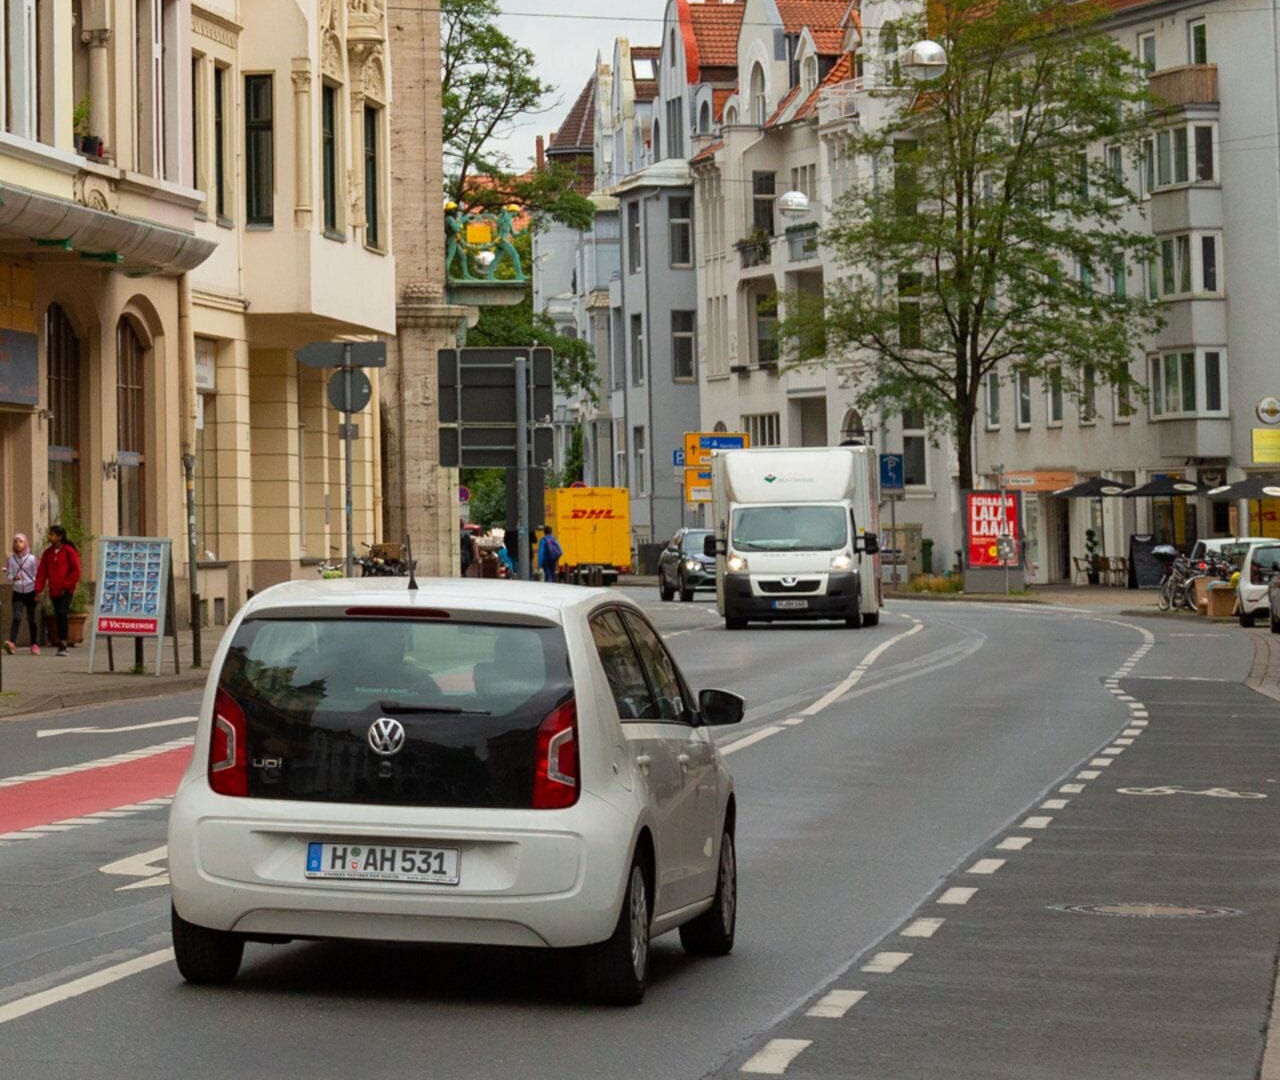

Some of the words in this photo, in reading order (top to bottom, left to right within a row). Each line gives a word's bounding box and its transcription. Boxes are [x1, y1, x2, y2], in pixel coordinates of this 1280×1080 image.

[571, 509, 615, 519] DHL
[109, 621, 154, 630] VICTORINOX
[331, 847, 348, 869] H
[363, 848, 397, 871] AH
[401, 850, 447, 875] 531
